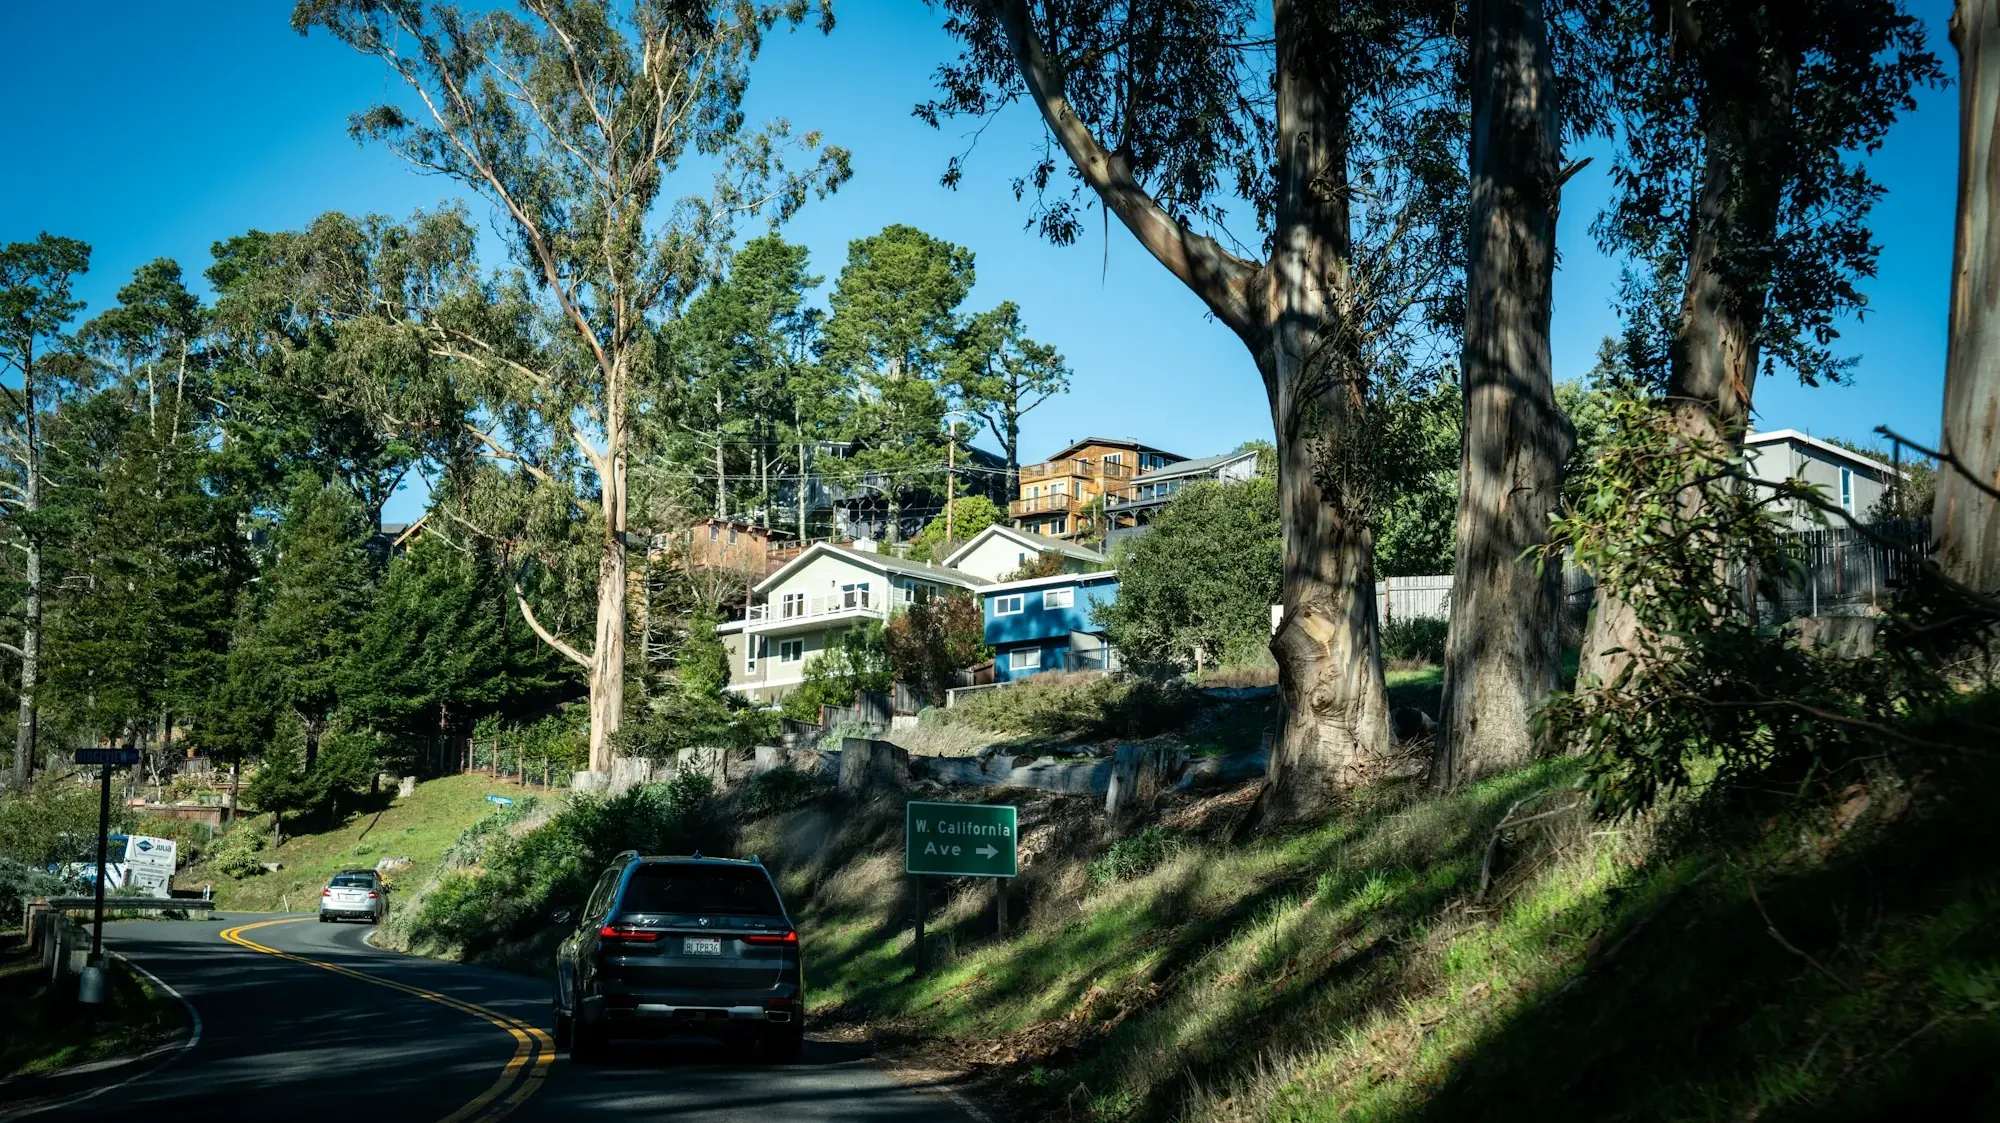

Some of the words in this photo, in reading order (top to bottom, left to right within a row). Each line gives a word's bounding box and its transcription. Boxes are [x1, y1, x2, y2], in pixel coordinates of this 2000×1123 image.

[916, 819, 930, 833] W.
[938, 820, 1011, 837] California
[923, 841, 961, 856] Ave
